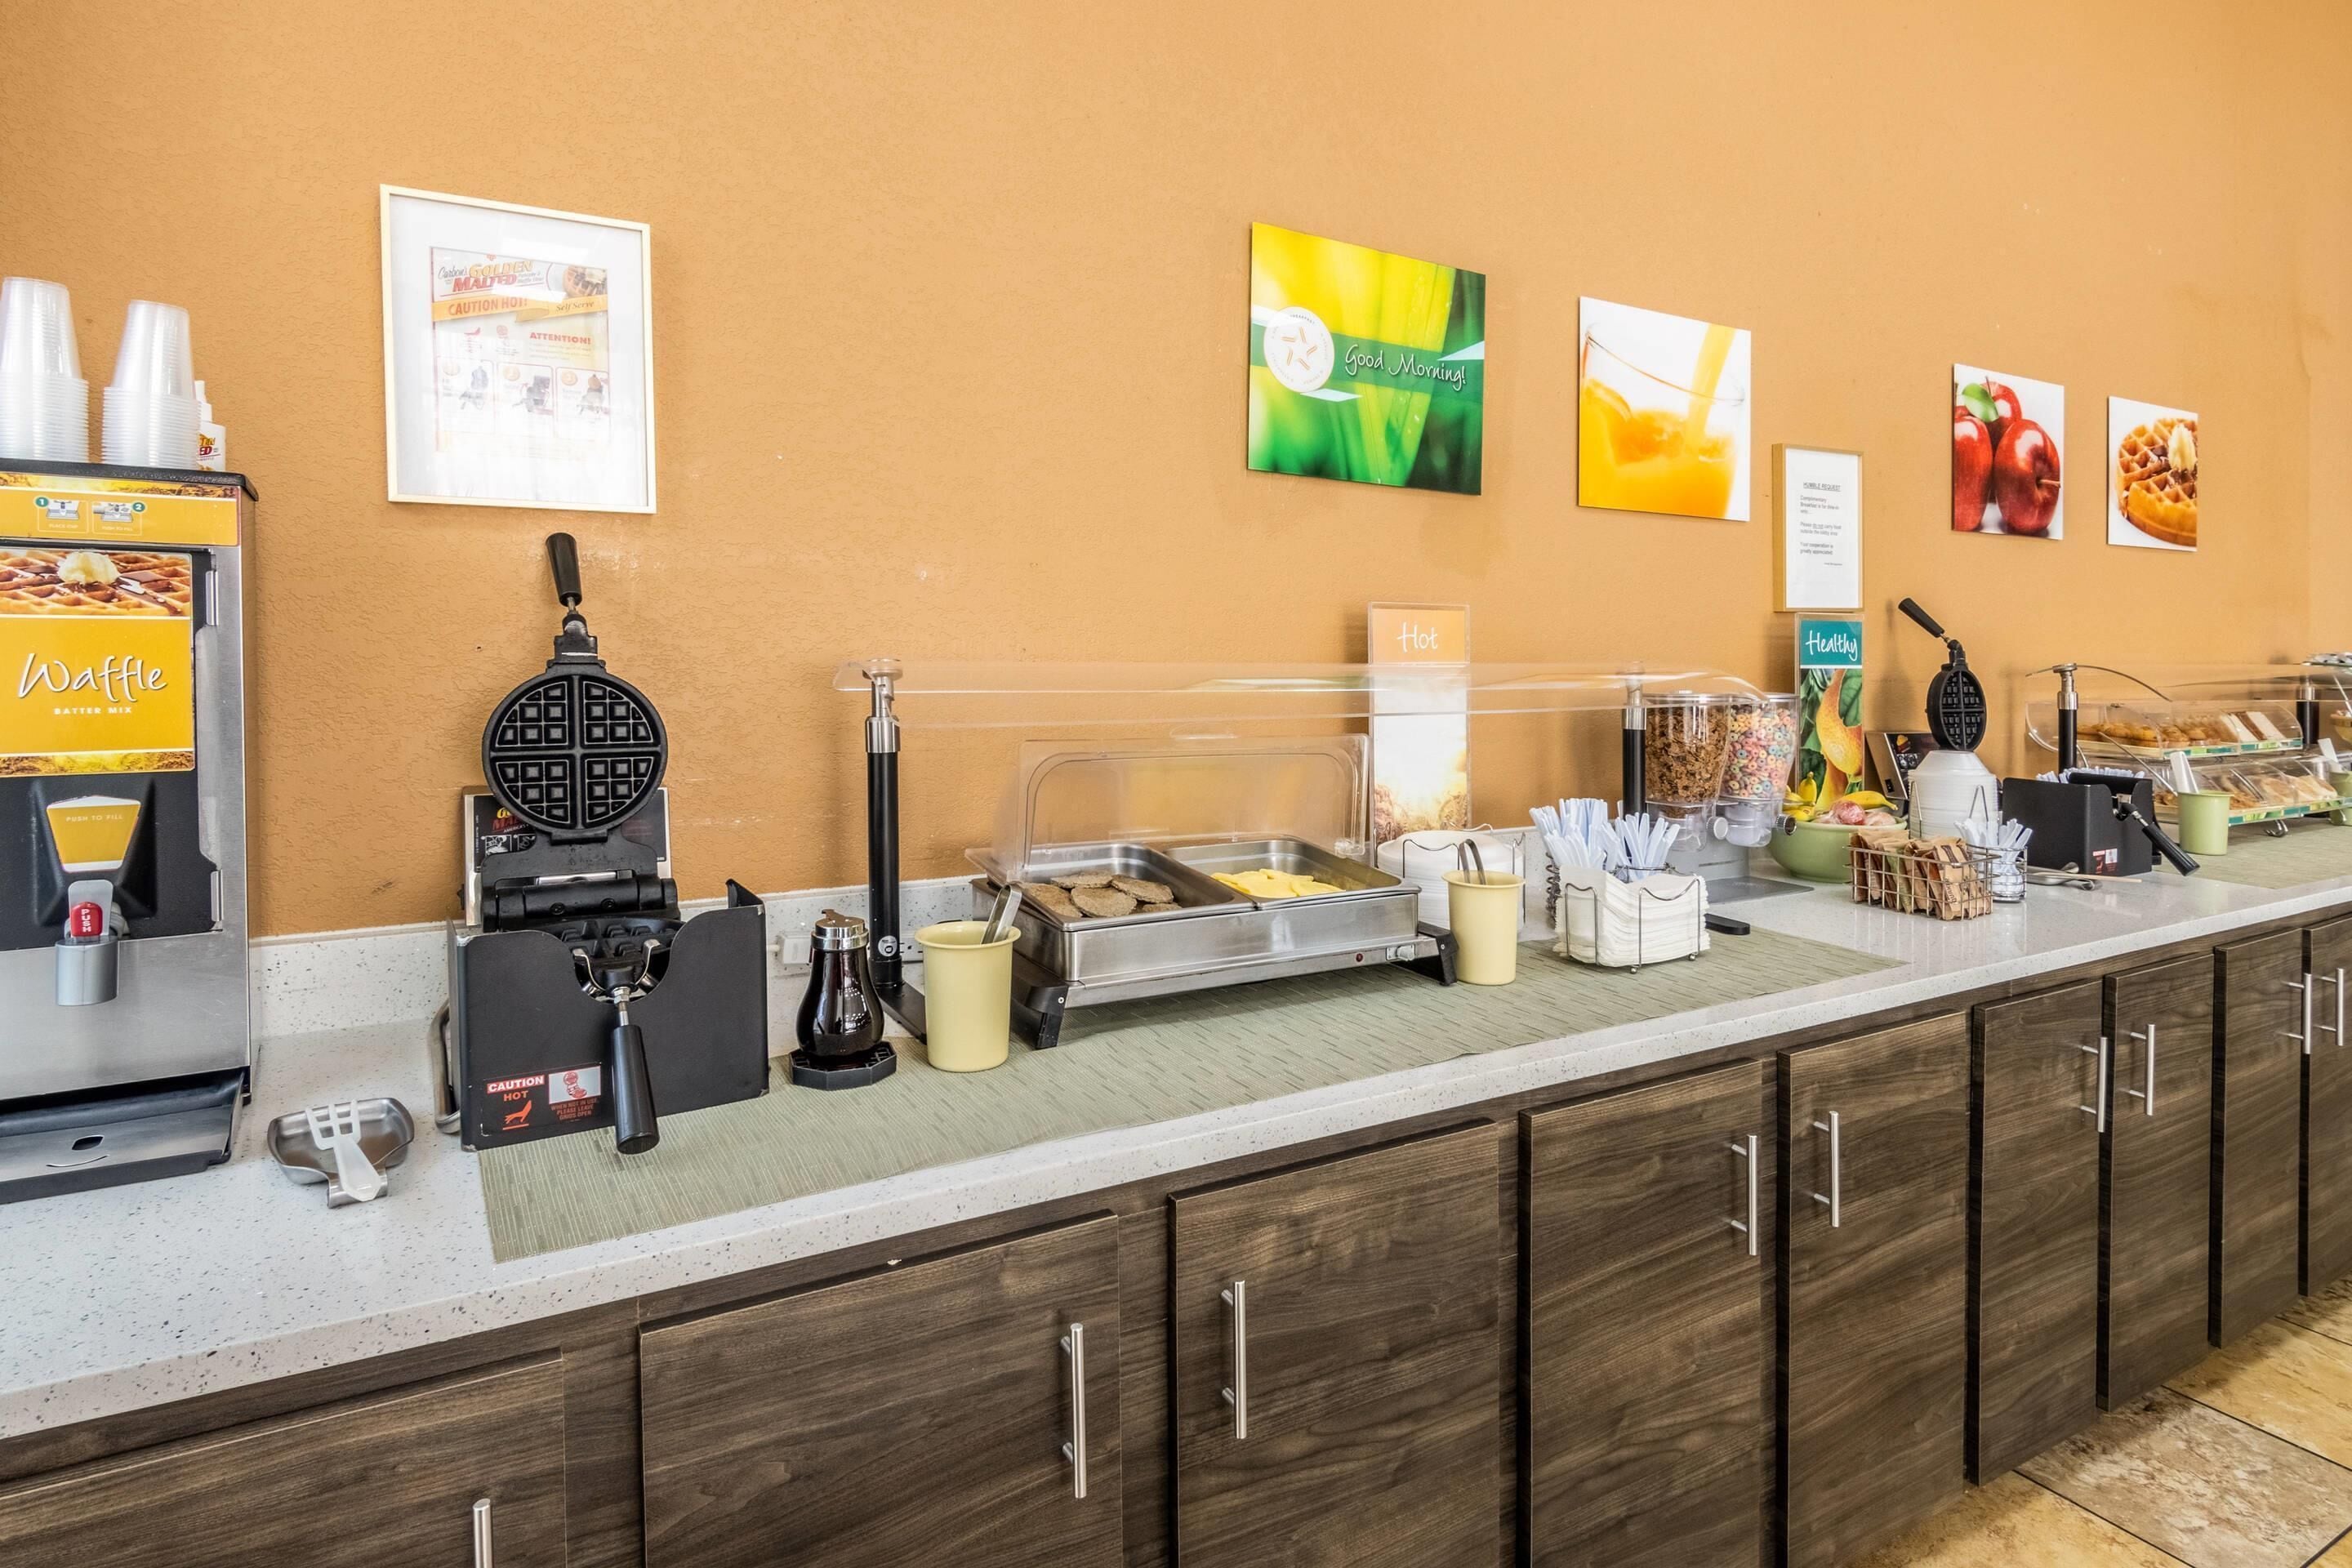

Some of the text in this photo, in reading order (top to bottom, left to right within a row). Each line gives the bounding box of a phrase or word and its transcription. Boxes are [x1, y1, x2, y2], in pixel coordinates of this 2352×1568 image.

[470, 261, 534, 278] GOLDEN
[452, 274, 517, 292] MALTED
[449, 296, 528, 315] CAUTION HOT!
[556, 301, 595, 313] Self Serve
[530, 332, 591, 345] ATTENTION!
[1345, 344, 1383, 376] Good
[1388, 353, 1466, 392] Morning!
[1397, 621, 1438, 653] Hot
[1806, 630, 1858, 662] Healthy
[18, 653, 167, 702] Waffle
[53, 706, 132, 715] BATTER MIX
[82, 909, 91, 933] PUSH
[489, 1075, 544, 1092] CAUTION
[504, 1090, 528, 1102] HOT
